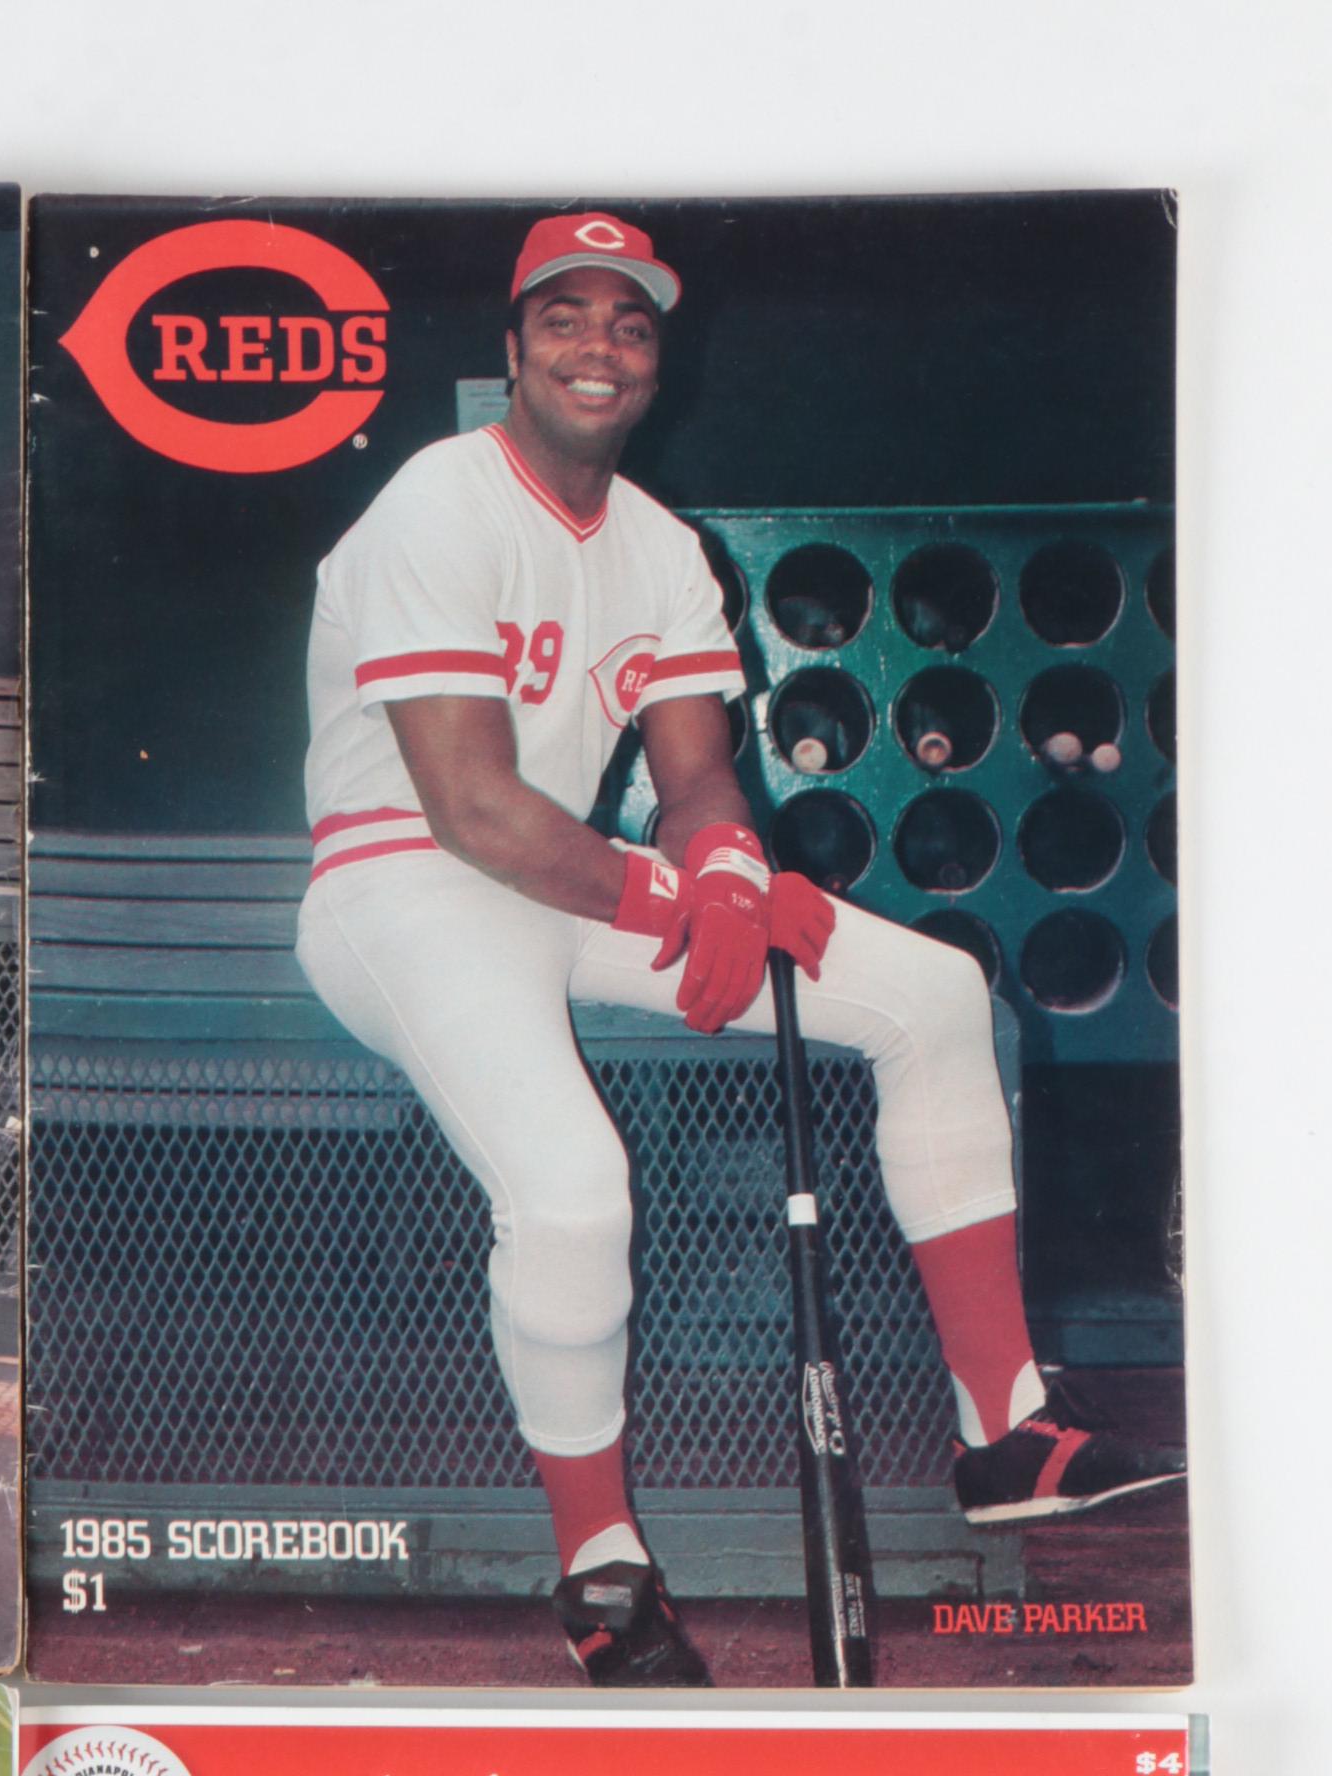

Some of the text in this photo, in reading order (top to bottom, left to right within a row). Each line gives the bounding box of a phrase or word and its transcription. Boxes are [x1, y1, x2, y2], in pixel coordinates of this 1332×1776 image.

[152, 314, 387, 383] REDS
[60, 1519, 409, 1560] 1985 SCOREBOOK
[62, 1570, 107, 1614] $1
[933, 1603, 1148, 1634] DAVE PARKER
[1136, 1751, 1183, 1775] $4
